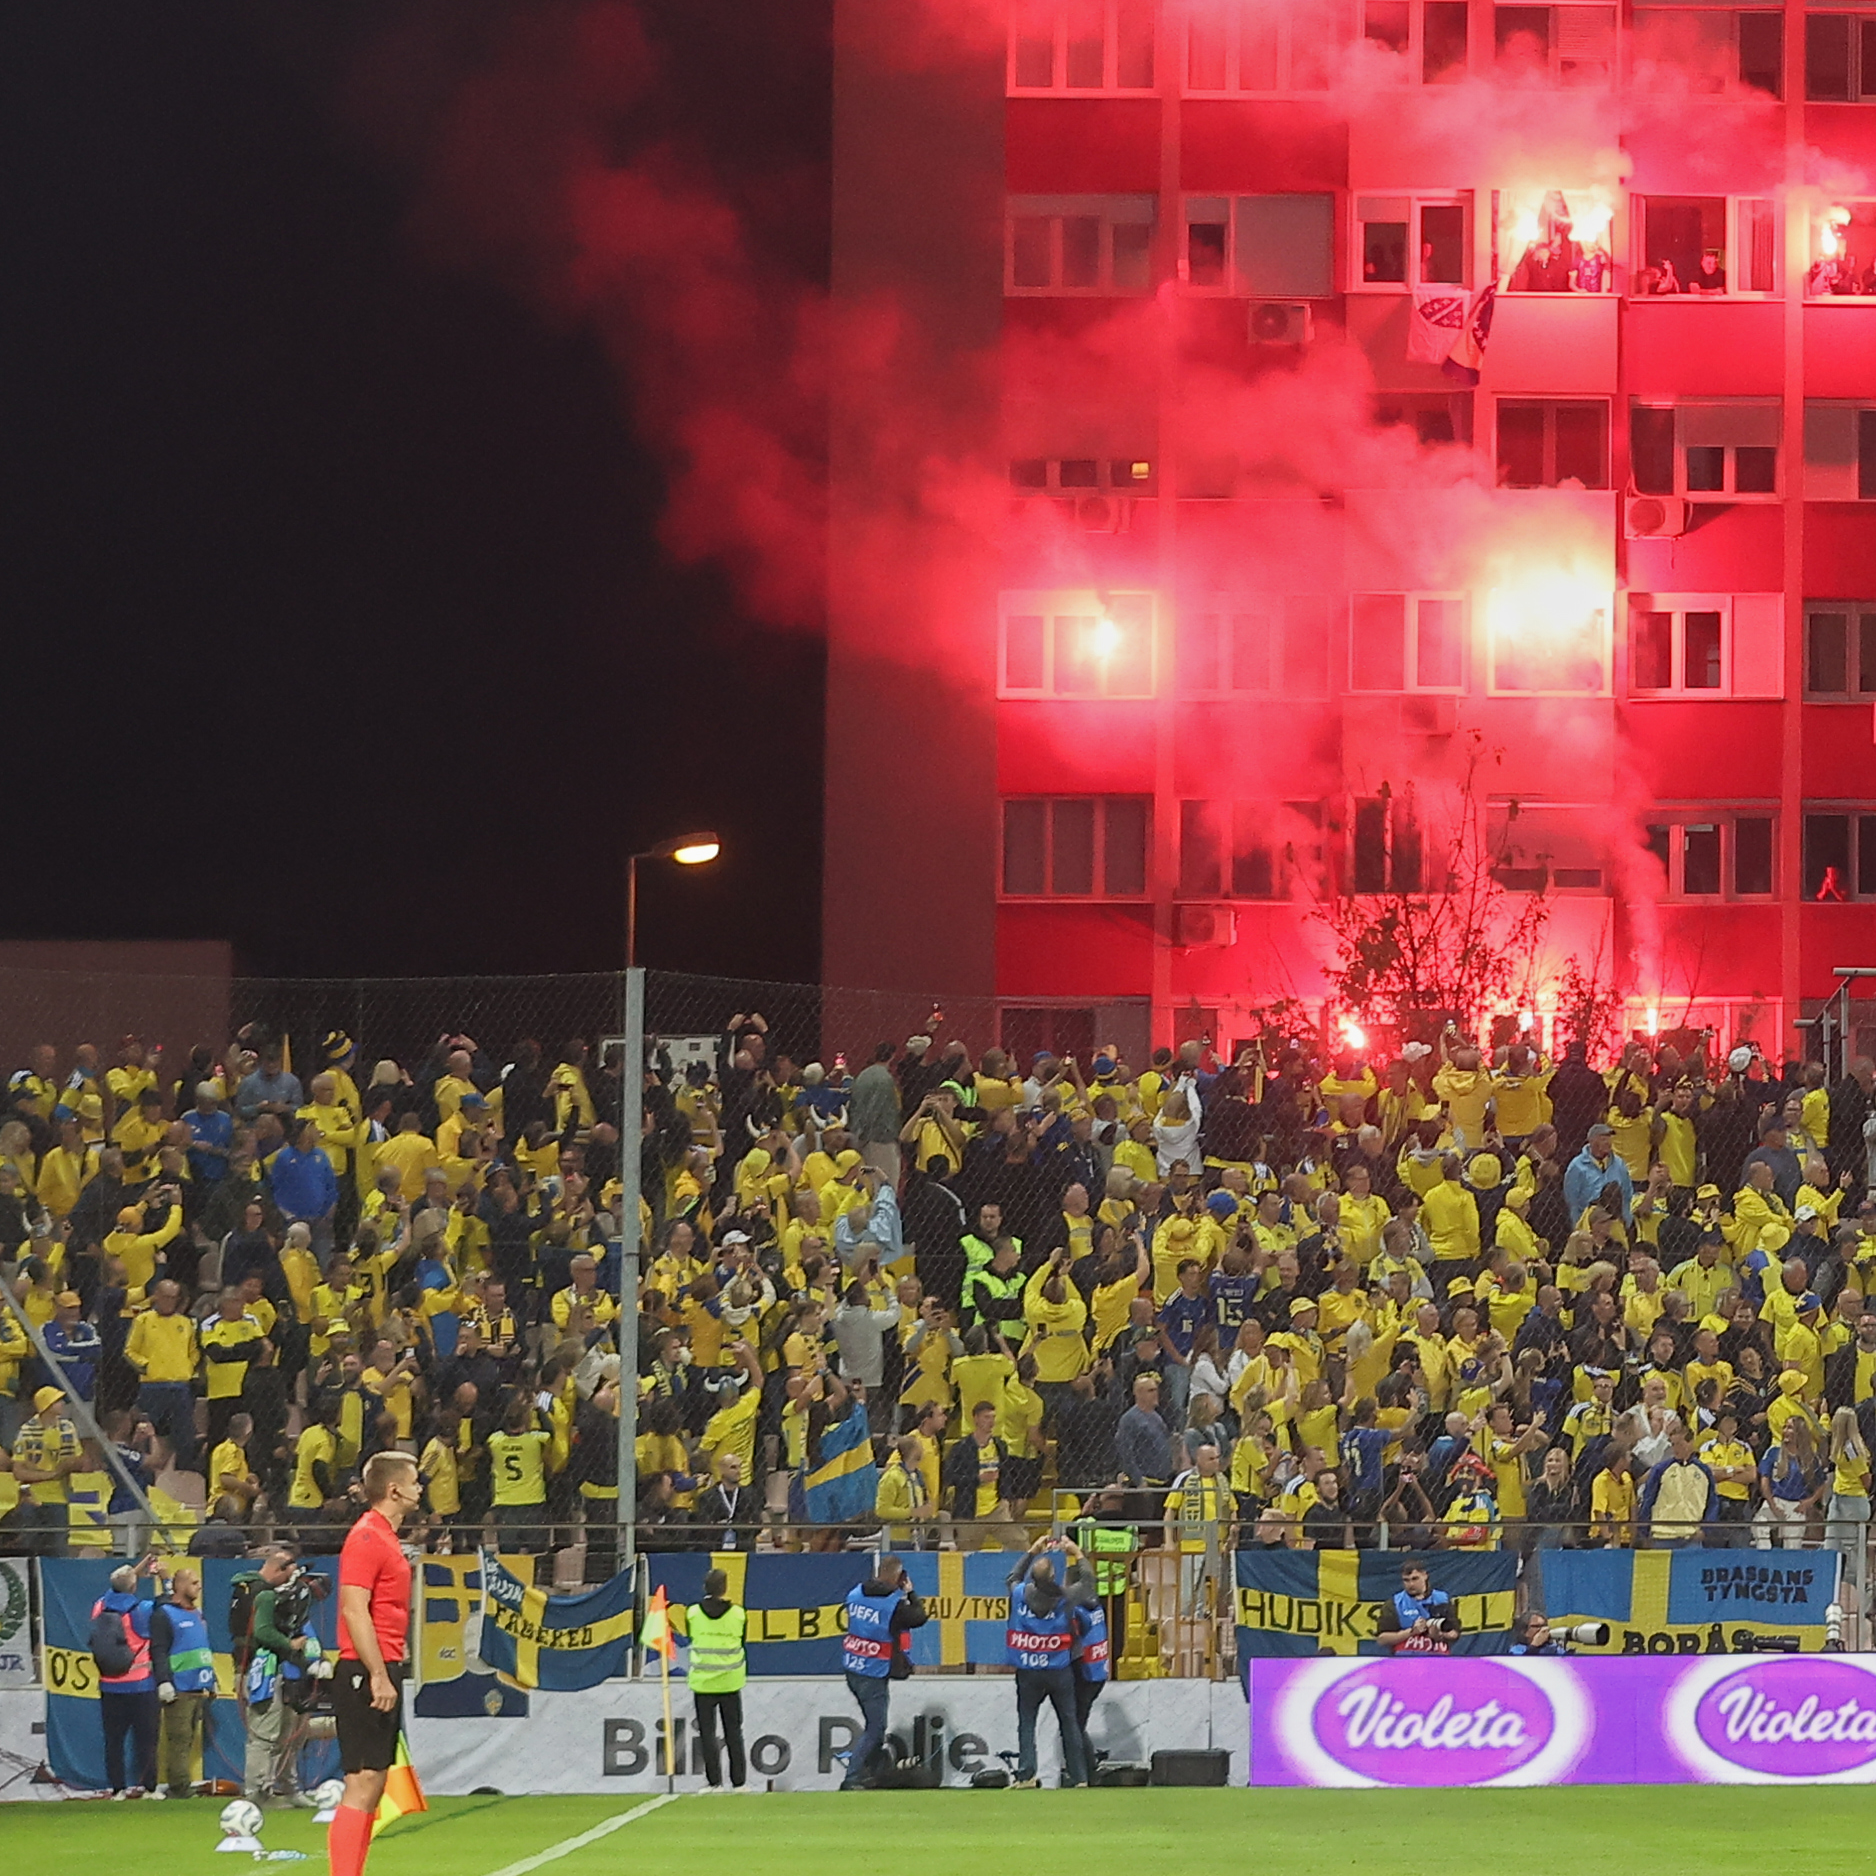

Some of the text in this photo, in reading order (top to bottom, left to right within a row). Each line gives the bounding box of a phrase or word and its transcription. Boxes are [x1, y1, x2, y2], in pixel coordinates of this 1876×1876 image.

[1216, 1297, 1244, 1328] 15
[1704, 1582, 1809, 1604] TYNGSTA
[848, 1602, 881, 1624] UEFA
[1010, 1631, 1062, 1650] PHOTO
[1019, 1651, 1050, 1668] 108
[1338, 1685, 1528, 1749] Violeta
